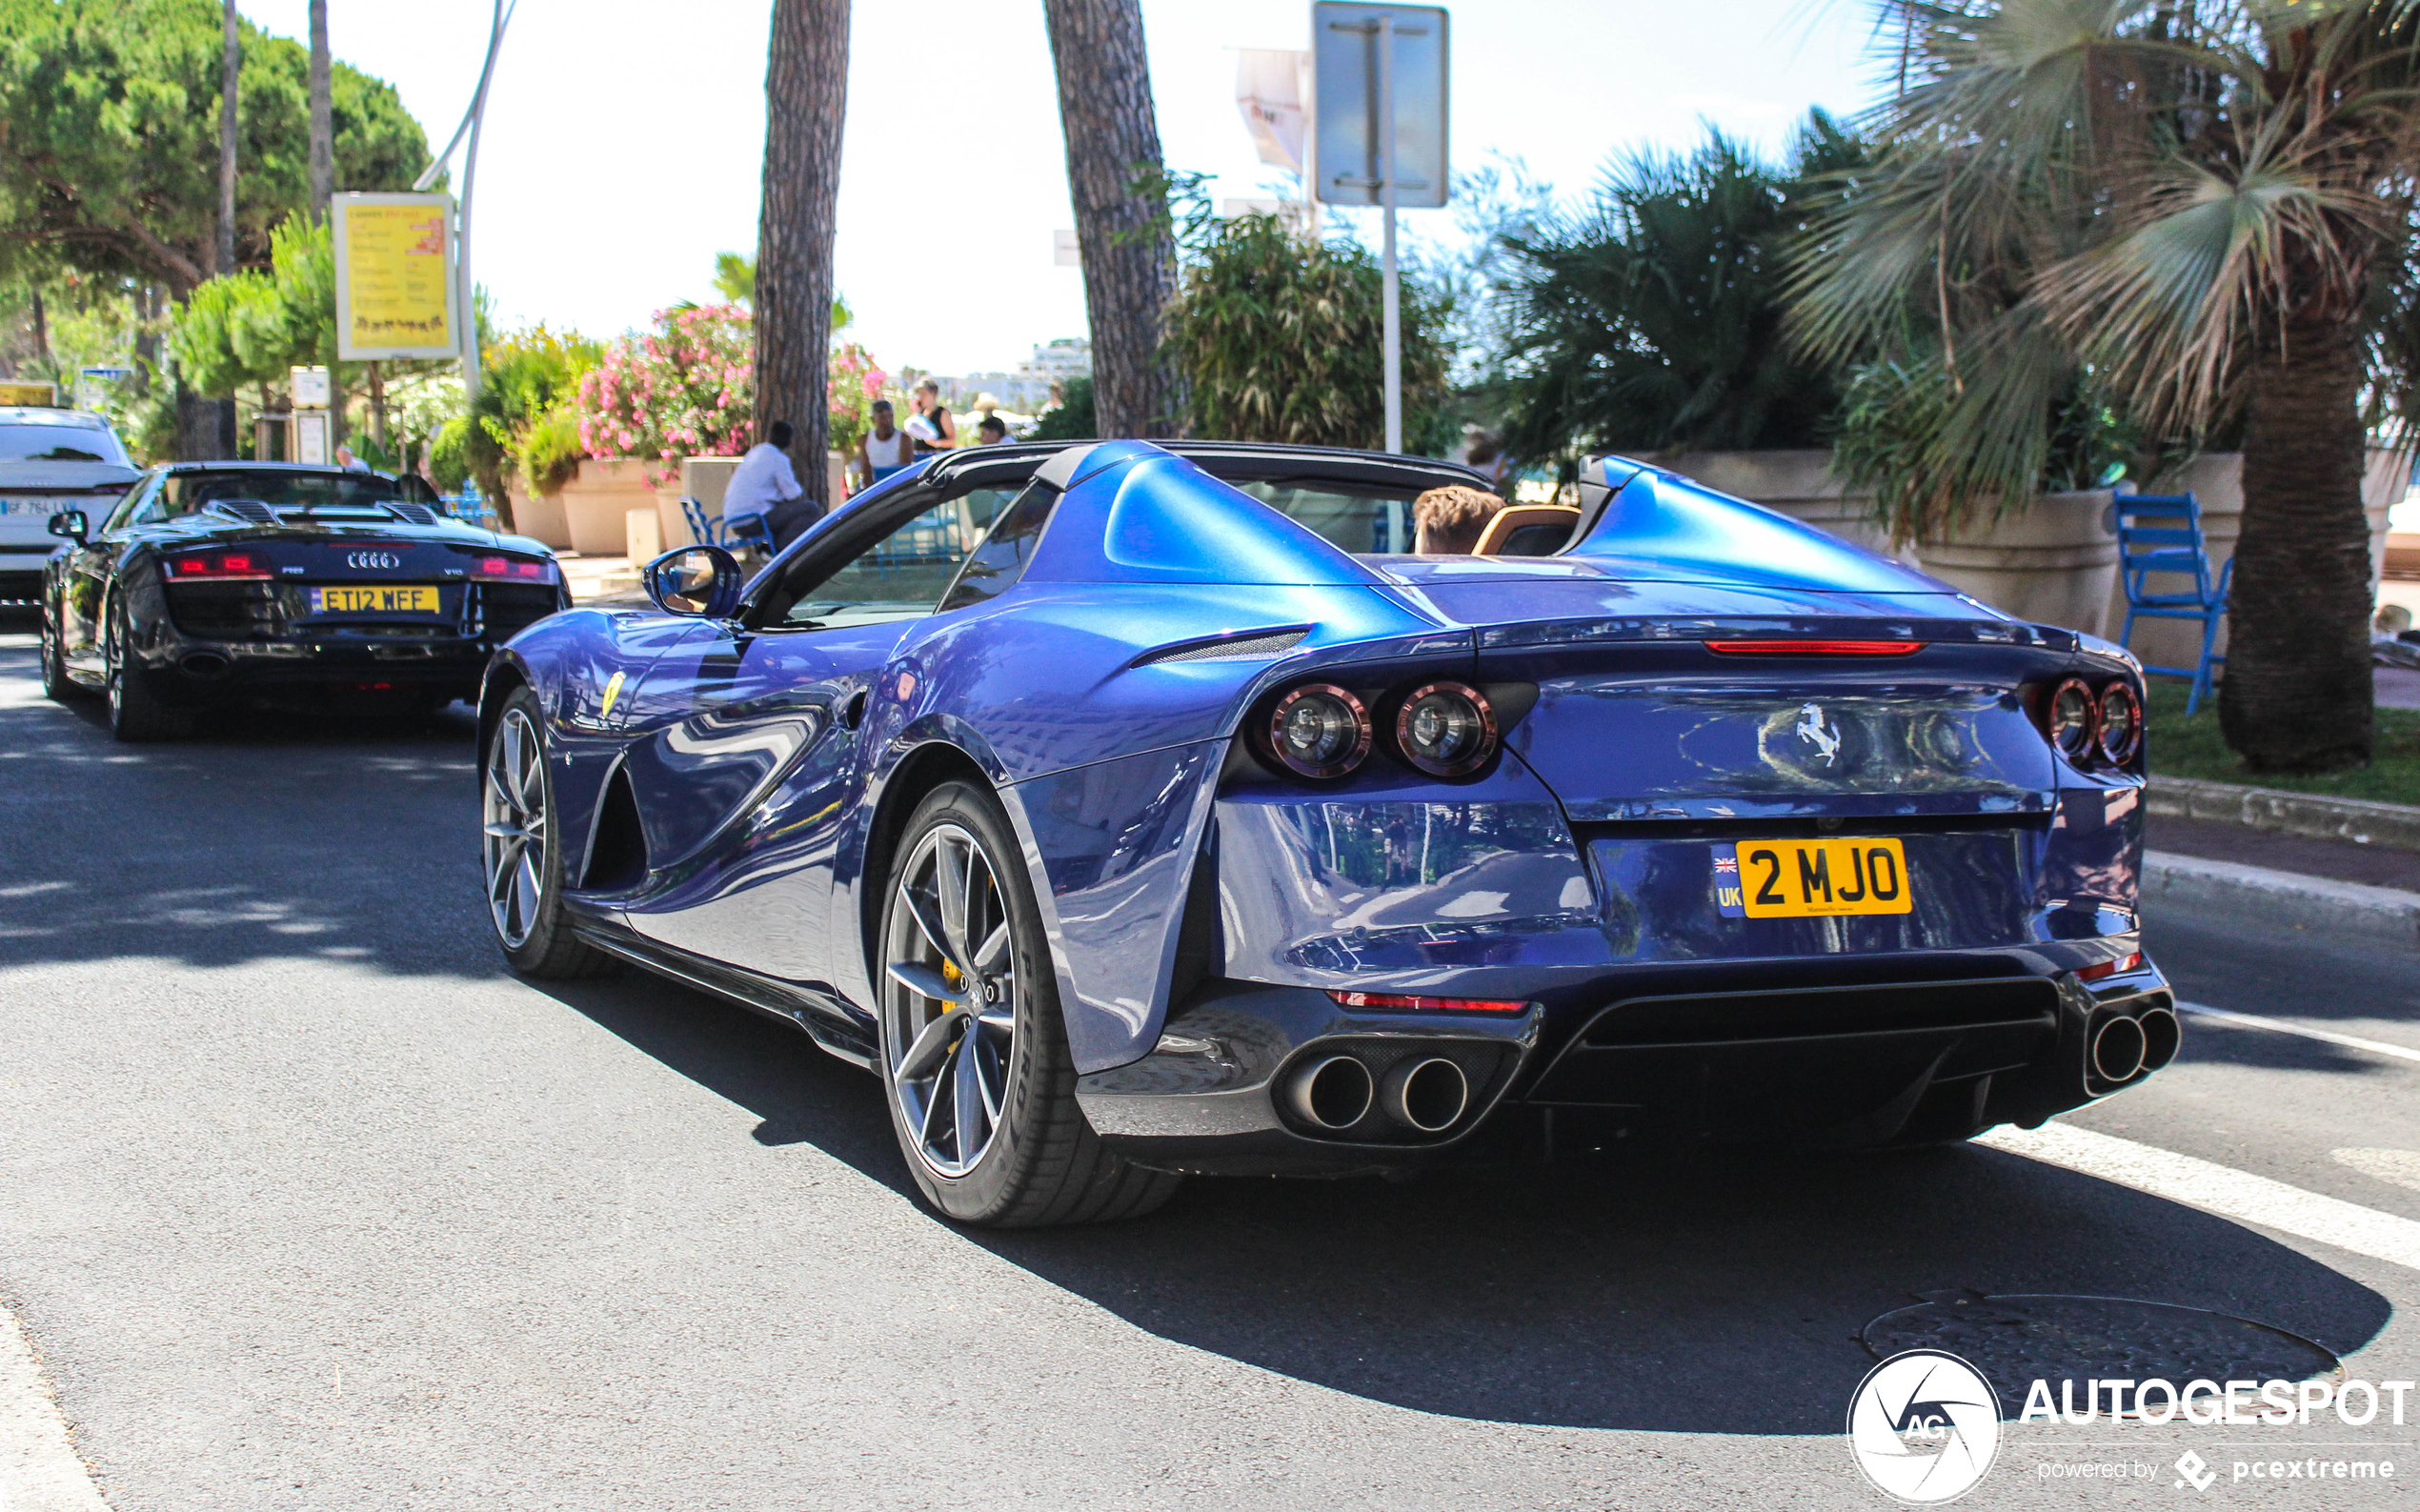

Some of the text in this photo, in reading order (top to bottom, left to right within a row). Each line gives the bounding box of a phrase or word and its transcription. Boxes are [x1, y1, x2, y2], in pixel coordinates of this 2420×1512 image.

[327, 590, 375, 612] ET12
[1749, 847, 1900, 905] 2 MJO
[1718, 886, 1743, 907] UK
[1016, 989, 1034, 1111] ZERO
